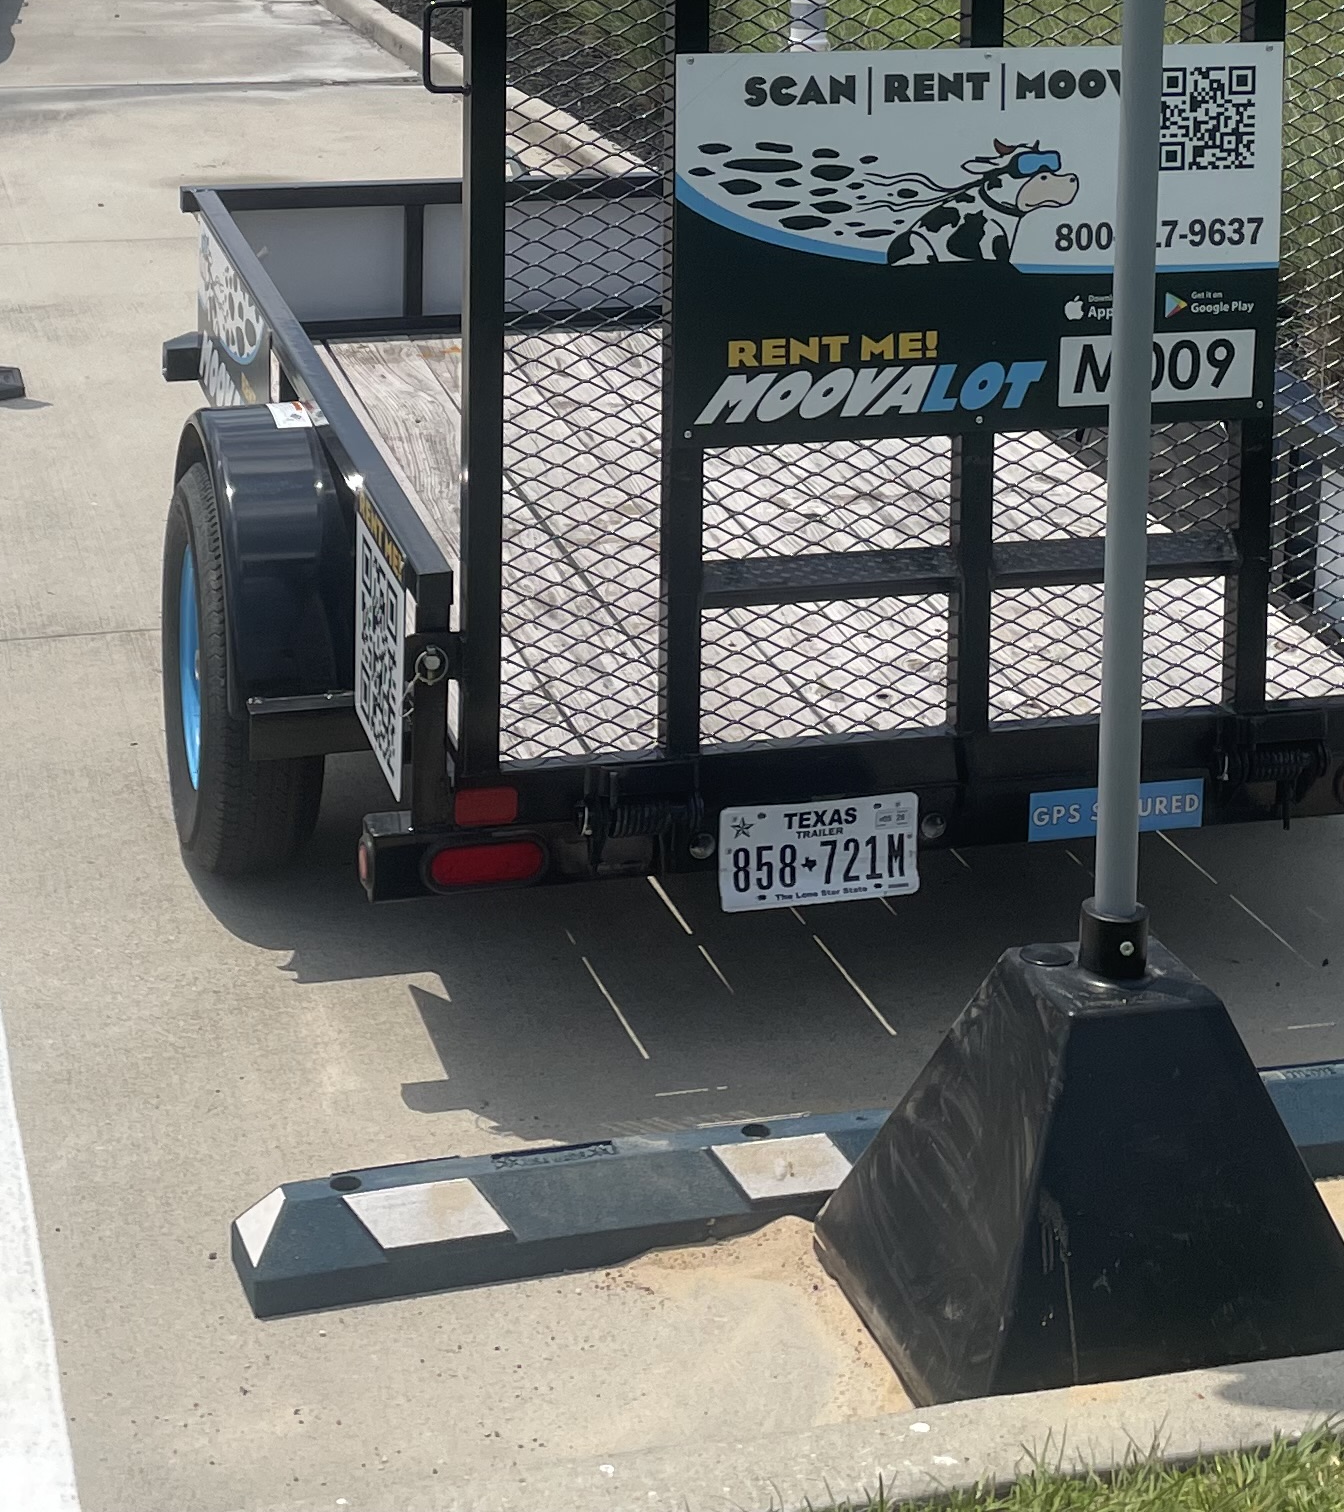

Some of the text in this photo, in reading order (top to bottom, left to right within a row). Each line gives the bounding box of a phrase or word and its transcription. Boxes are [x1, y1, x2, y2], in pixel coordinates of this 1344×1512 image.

[744, 74, 856, 108] SCAN
[884, 72, 990, 103] RENT
[1055, 217, 1264, 252] 8007-9637
[1190, 301, 1255, 315] Google Play
[727, 330, 939, 368] RENT ME!
[693, 360, 1048, 425] MOOVALOT
[783, 807, 857, 830] TEXAS
[1032, 794, 1199, 826] GPS SURED
[796, 827, 844, 839] TRAILER
[733, 833, 905, 893] 858 721M
